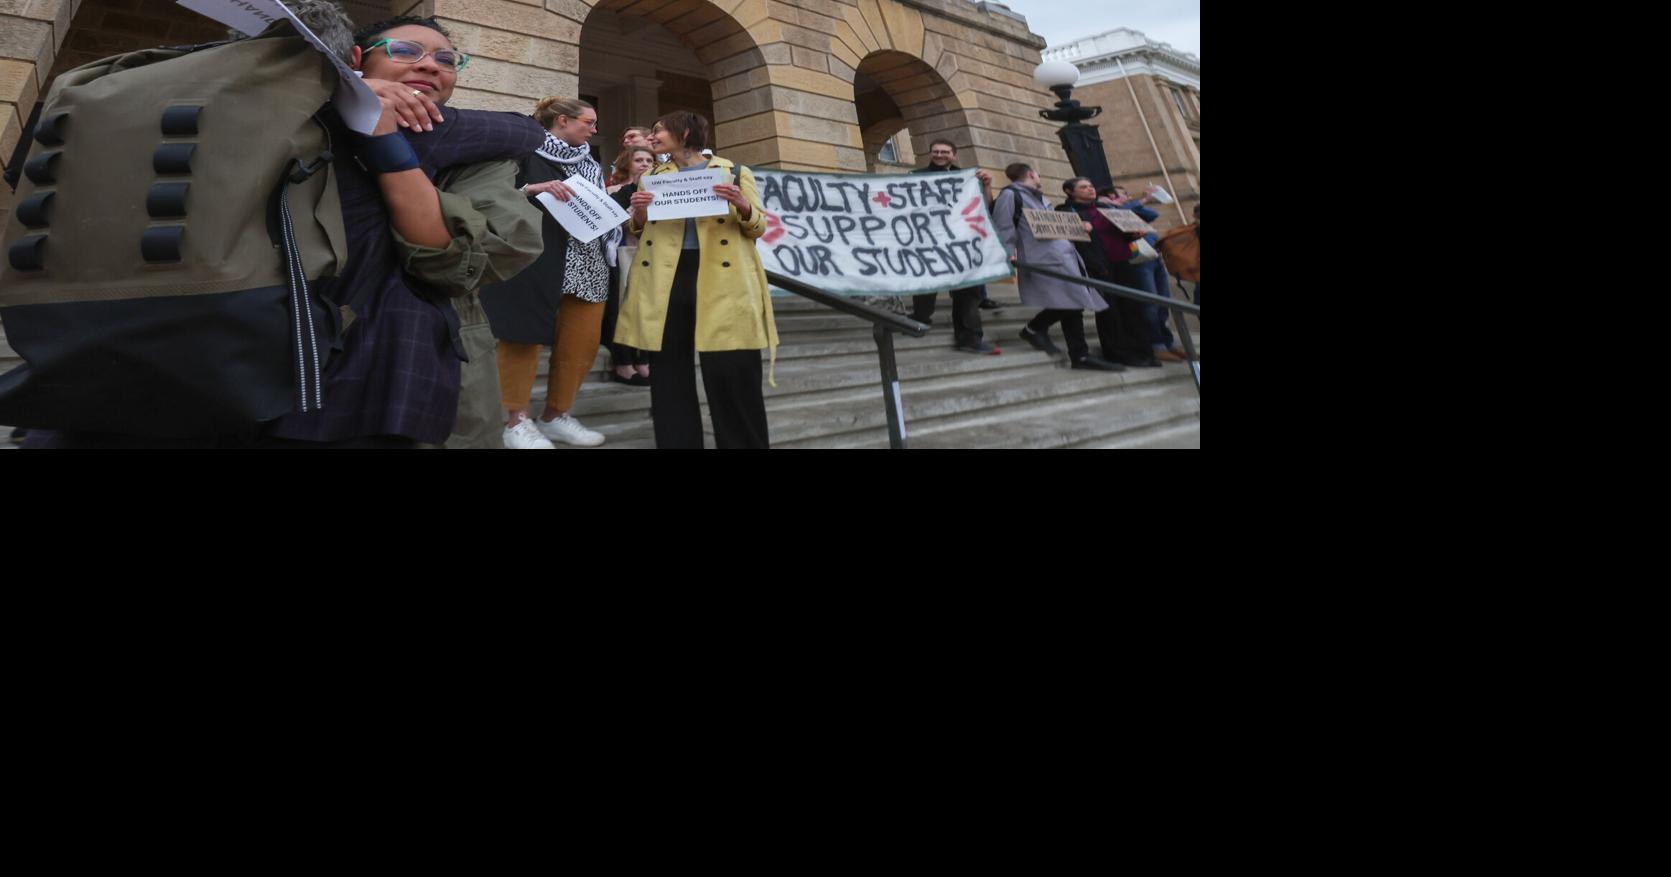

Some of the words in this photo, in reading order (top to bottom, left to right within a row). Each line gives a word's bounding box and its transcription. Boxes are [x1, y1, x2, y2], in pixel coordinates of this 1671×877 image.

[574, 195, 591, 211] ANDS
[589, 208, 602, 221] OFF
[662, 189, 692, 198] HANDS
[673, 194, 719, 205] STUDENTS!
[754, 174, 873, 214] ACULTY
[886, 177, 965, 209] STAFF
[567, 200, 600, 232] STUDENTS!
[781, 209, 956, 246] SUPPORT
[772, 244, 844, 276] OUR
[852, 238, 984, 277] STUDENTS
